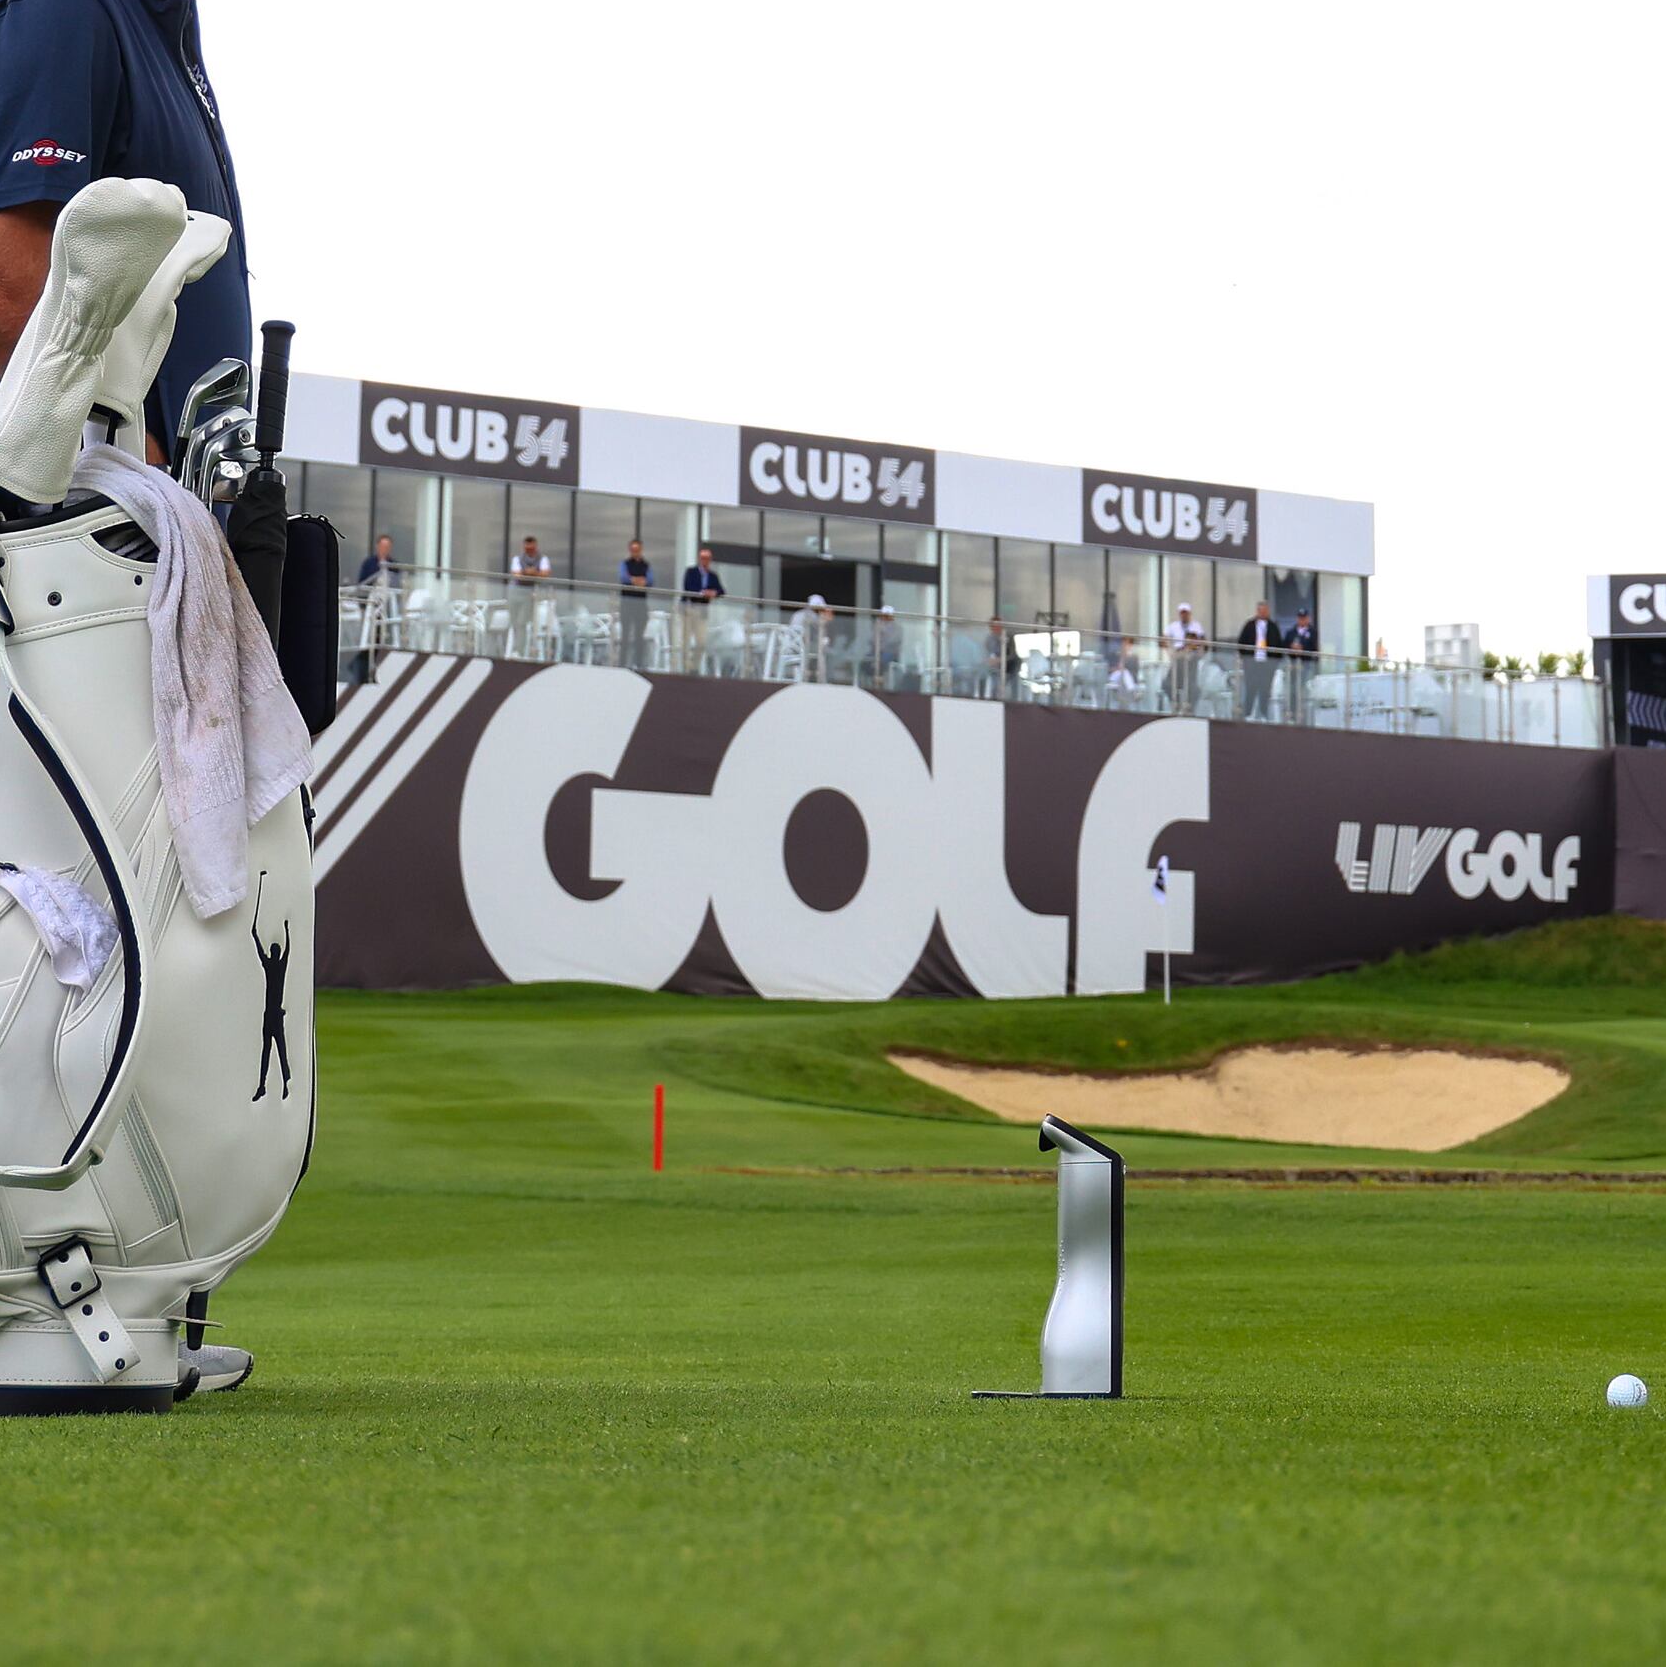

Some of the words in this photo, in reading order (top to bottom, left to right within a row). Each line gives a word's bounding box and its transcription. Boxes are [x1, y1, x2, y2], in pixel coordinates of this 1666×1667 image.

[12, 147, 87, 163] ODYSSEY
[371, 397, 509, 464] CLUB
[514, 414, 569, 470] 54
[749, 442, 872, 504] CLUB
[877, 457, 925, 510] 54
[1090, 483, 1202, 541] CLUB
[1205, 497, 1249, 546] 54
[459, 664, 1210, 1001] GOLF
[1335, 821, 1453, 895] LIV
[1445, 827, 1582, 904] GOLF
